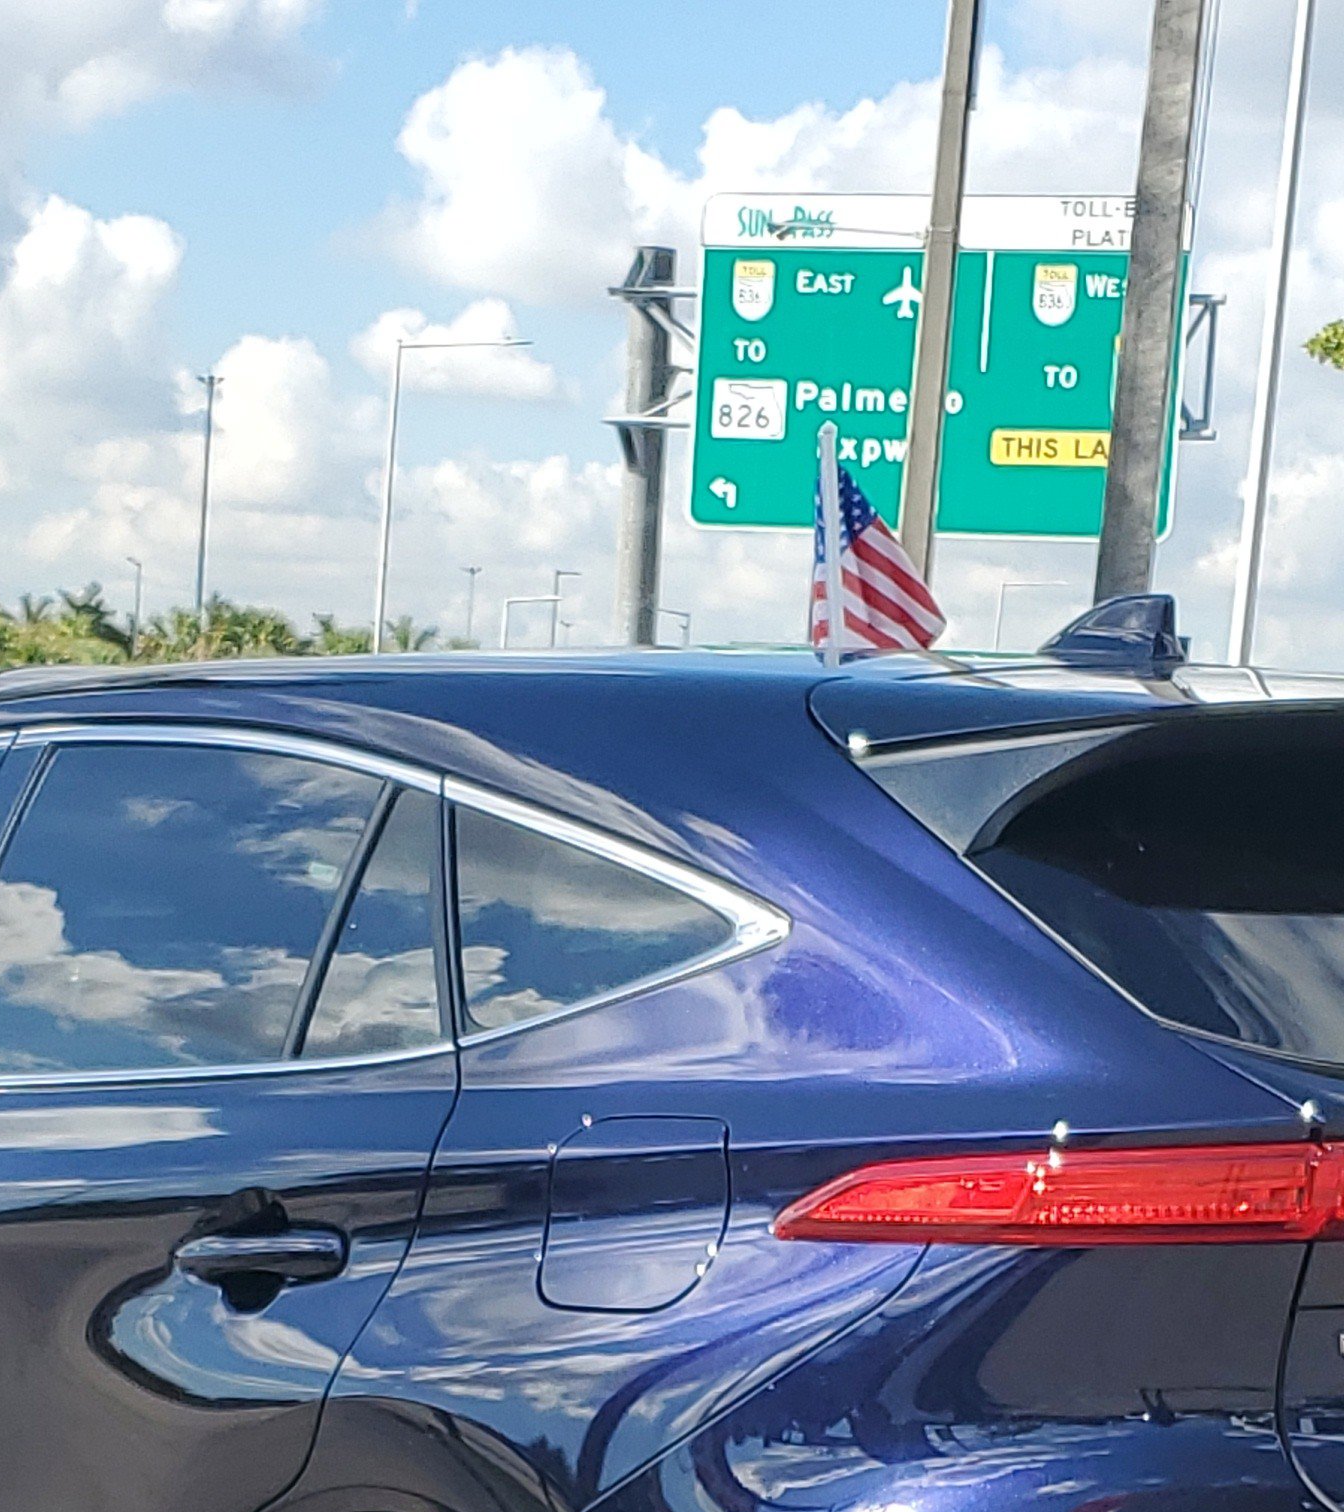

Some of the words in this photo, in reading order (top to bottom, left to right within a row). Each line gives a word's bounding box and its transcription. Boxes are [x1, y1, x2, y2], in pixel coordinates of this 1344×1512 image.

[1072, 230, 1130, 246] PLAT
[796, 269, 855, 294] EAST
[1085, 273, 1127, 297] WE
[733, 338, 767, 362] TO
[1043, 364, 1078, 389] TO
[795, 381, 964, 415] Palmeo
[718, 404, 770, 428] 826
[816, 437, 907, 468] xpw
[1001, 437, 1058, 459] THIS
